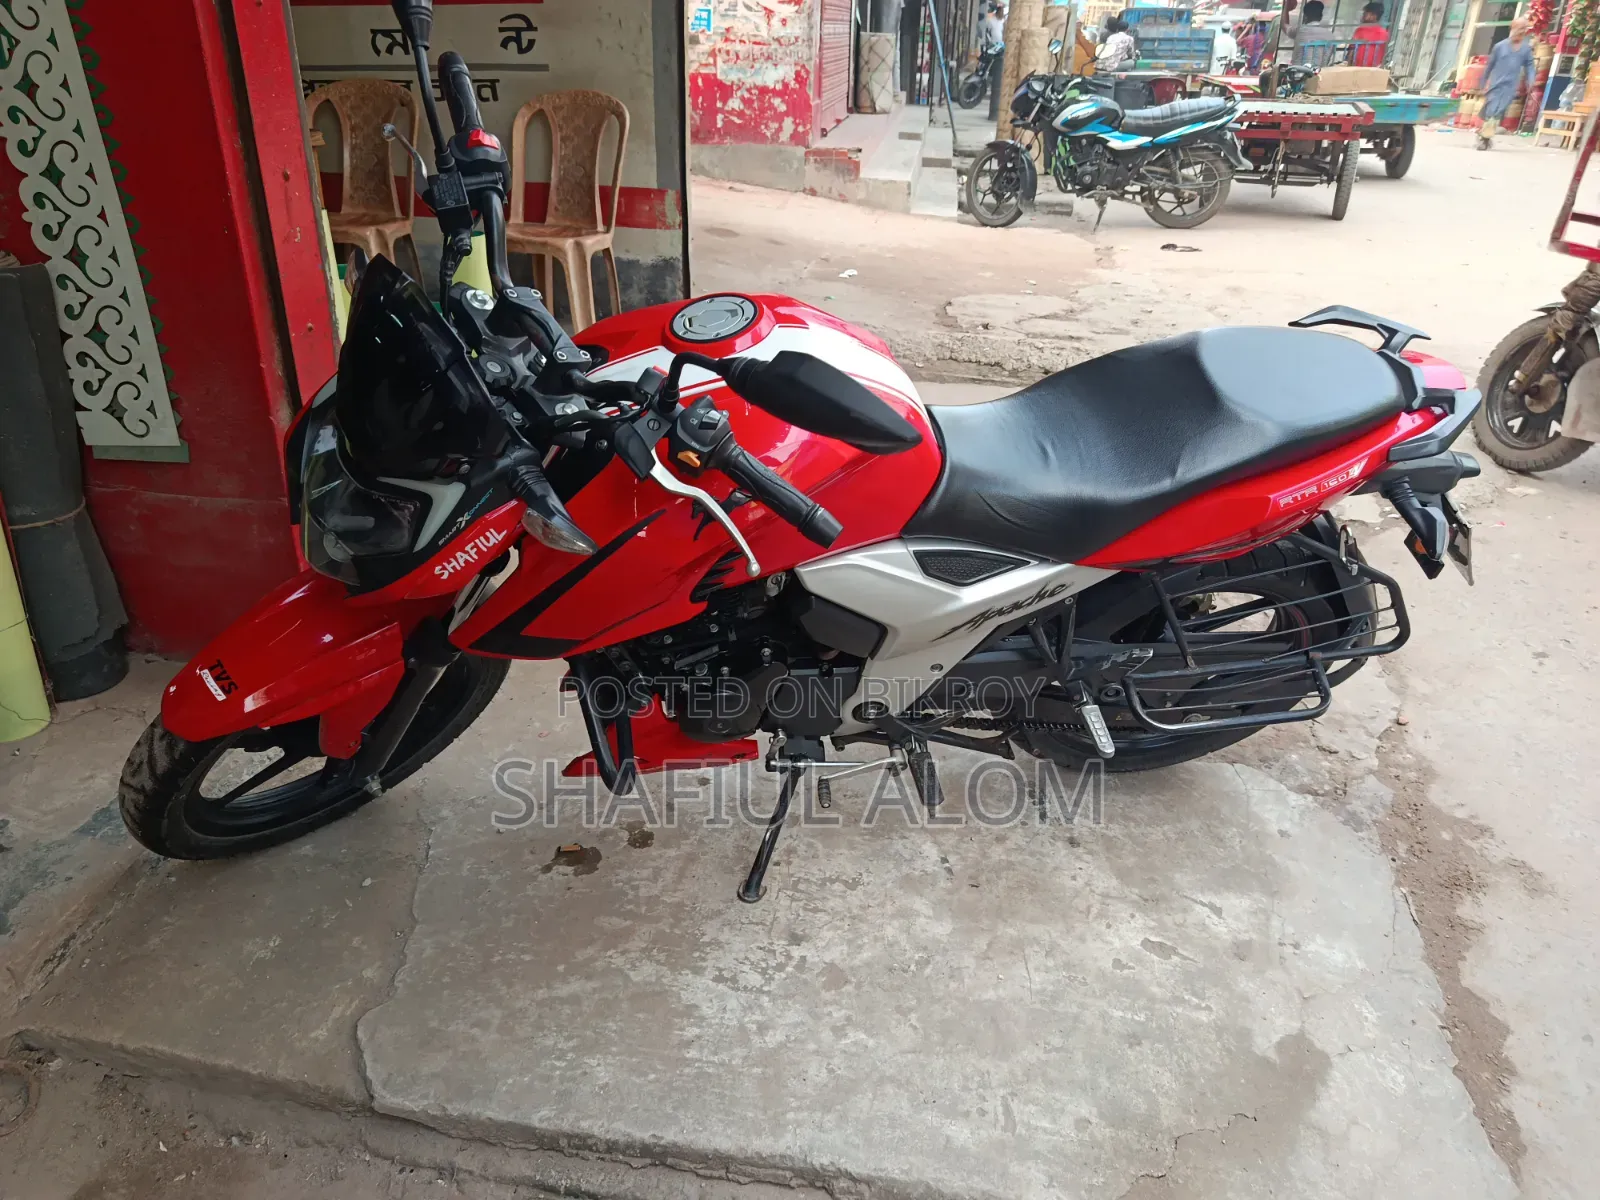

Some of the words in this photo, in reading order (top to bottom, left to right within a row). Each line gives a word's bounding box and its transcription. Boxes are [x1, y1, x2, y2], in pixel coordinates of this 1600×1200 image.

[1279, 483, 1319, 508] RTR
[434, 526, 508, 580] SHAFIUL
[208, 658, 239, 696] TVS
